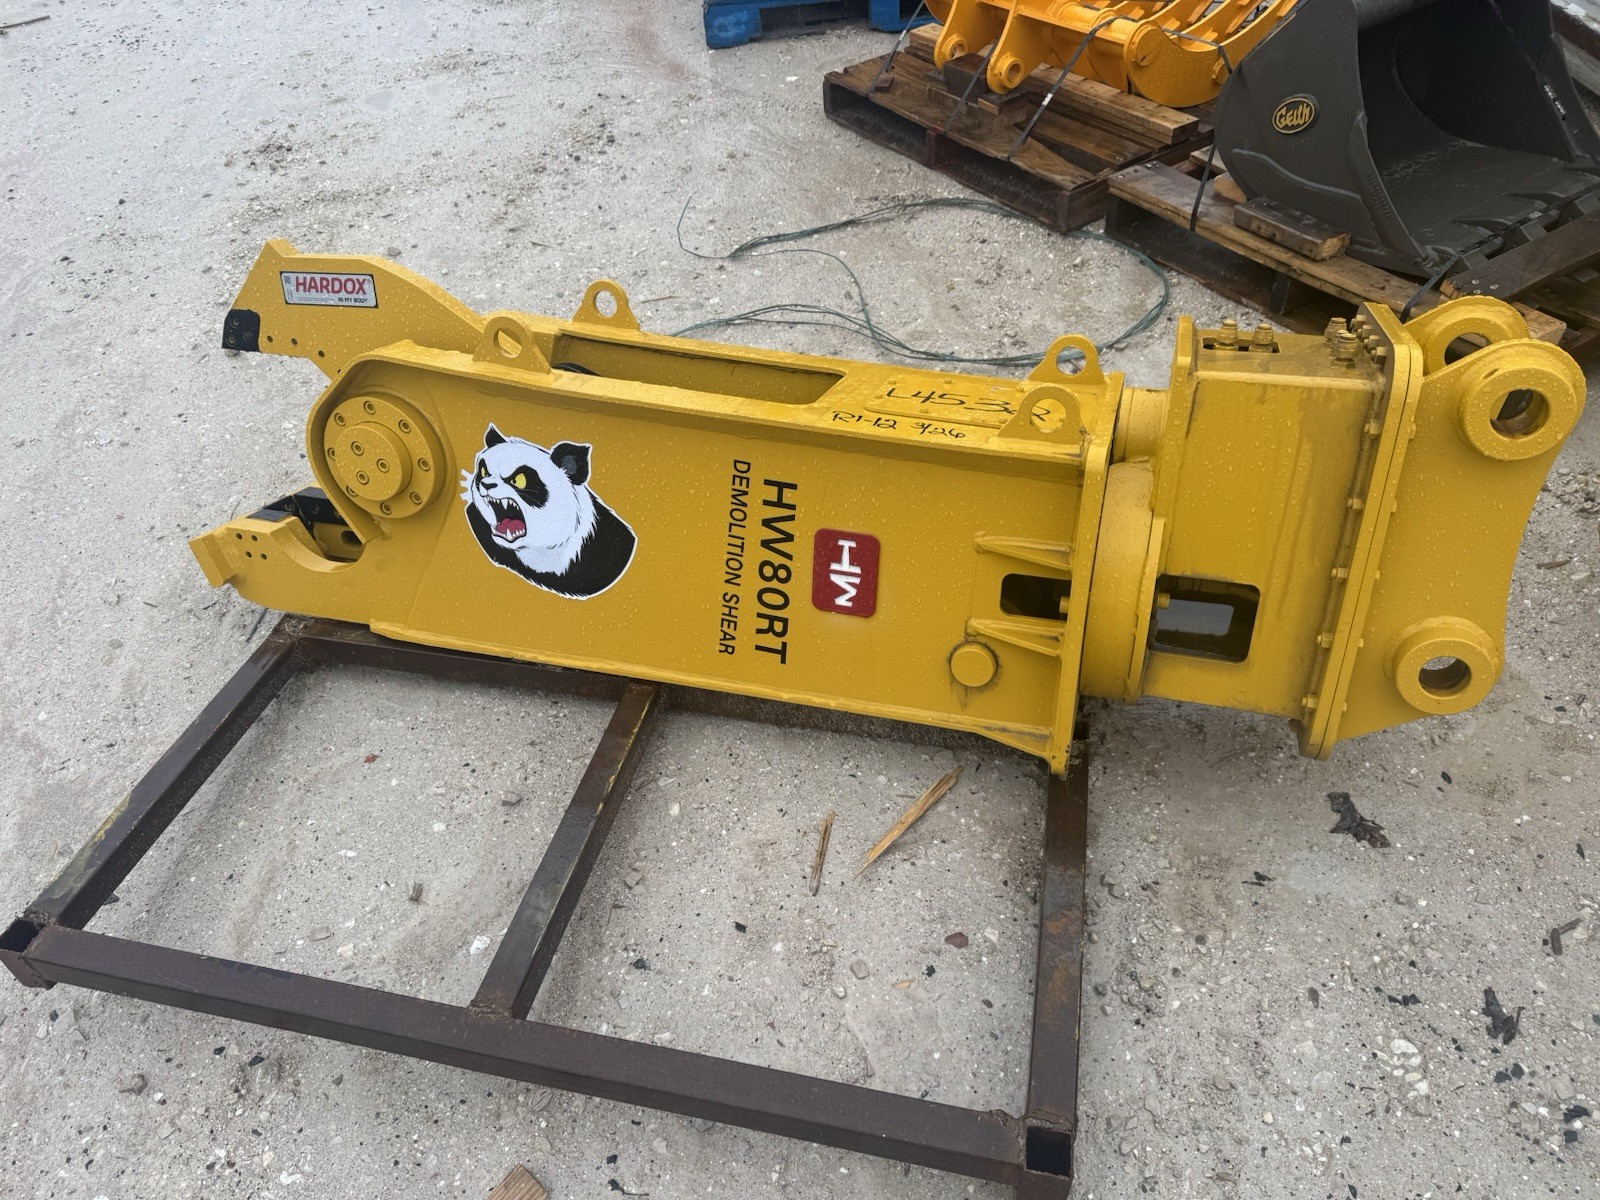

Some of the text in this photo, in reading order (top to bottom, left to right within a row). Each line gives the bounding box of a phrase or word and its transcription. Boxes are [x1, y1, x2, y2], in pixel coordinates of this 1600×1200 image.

[295, 276, 367, 295] HARDOX
[718, 459, 751, 656] DEMOLITION SHEAR
[754, 478, 798, 664] HW80RT
